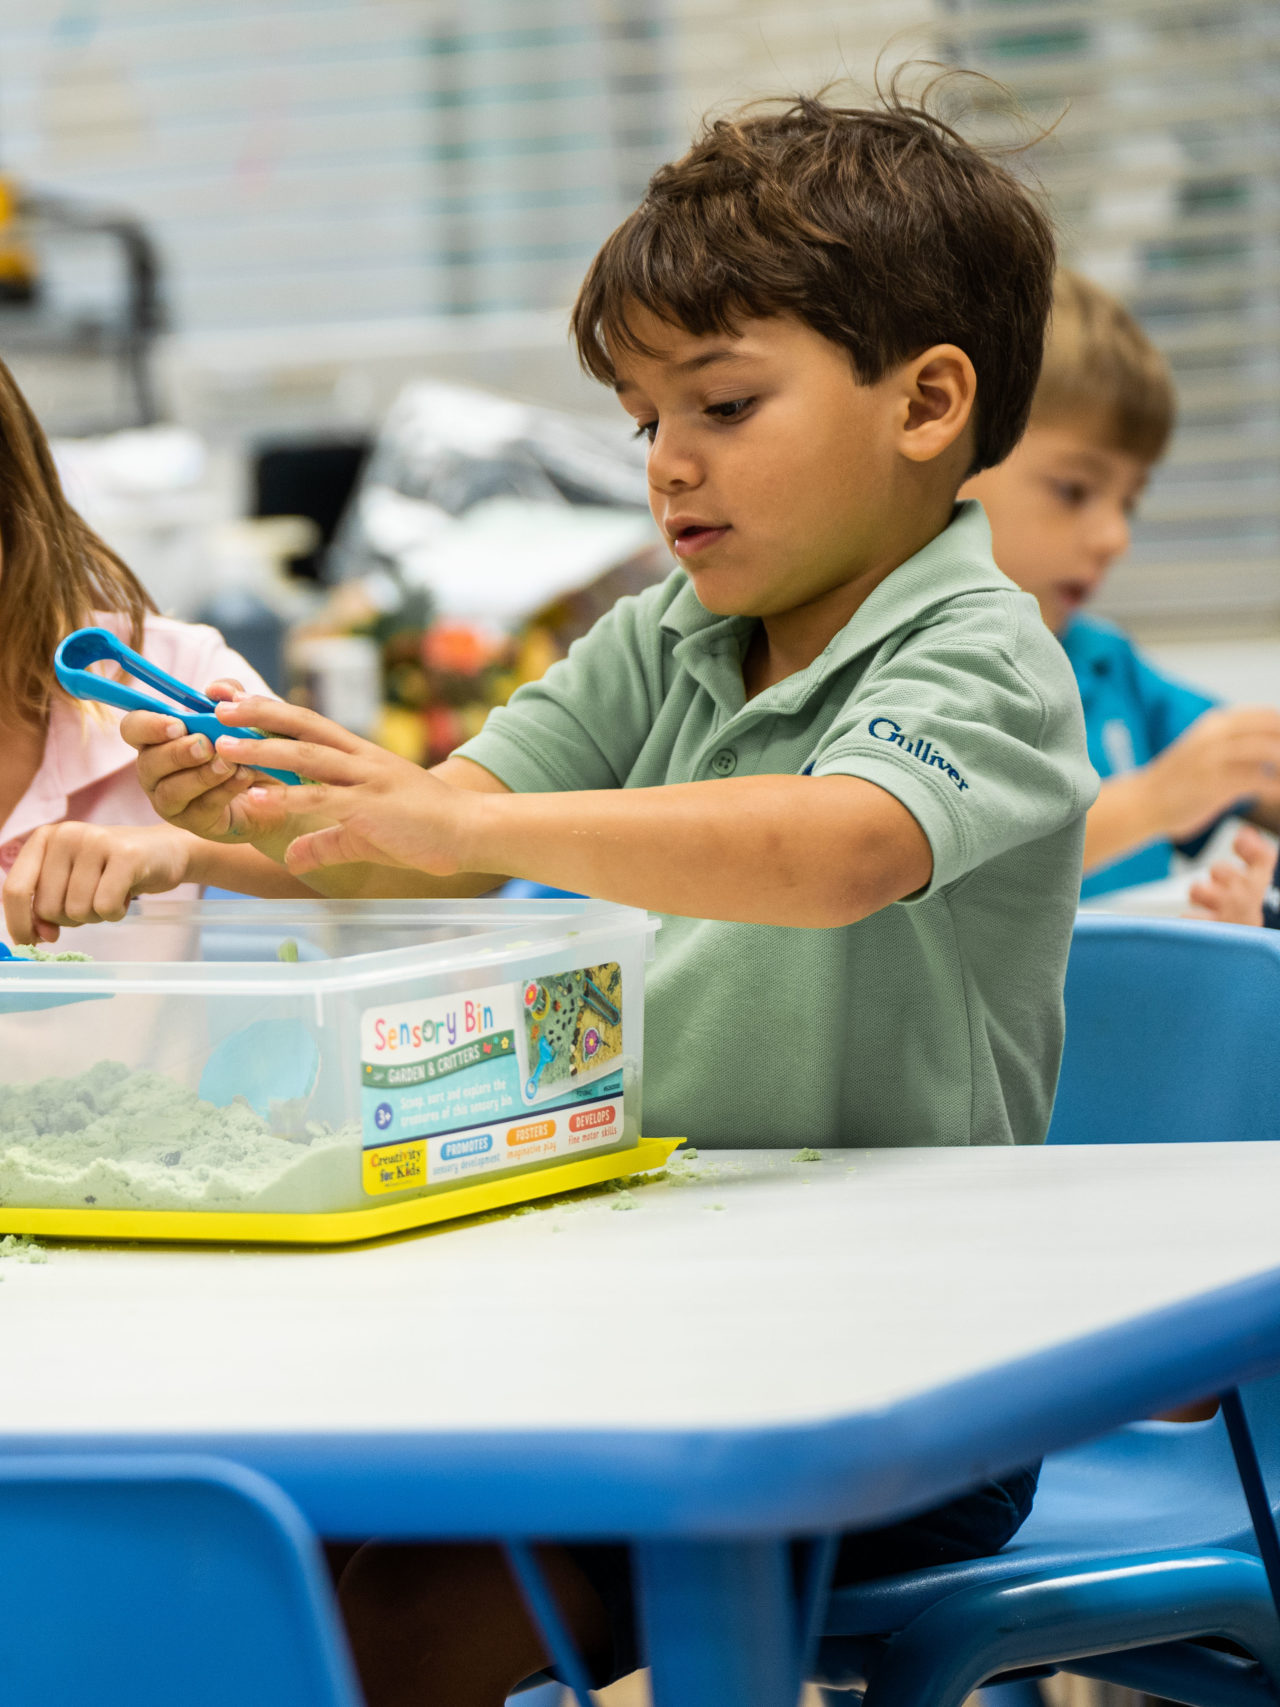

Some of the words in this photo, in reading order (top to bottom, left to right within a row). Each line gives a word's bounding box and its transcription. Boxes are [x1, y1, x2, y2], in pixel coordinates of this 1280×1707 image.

[868, 717, 969, 792] Gulliver
[374, 1012, 457, 1051] Sensory
[464, 1000, 494, 1034] Bin
[388, 1063, 426, 1084] GARDEN
[427, 1061, 436, 1077] &
[438, 1044, 480, 1073] CRITTERS
[447, 1087, 461, 1101] and
[463, 1083, 491, 1099] explore
[493, 1079, 506, 1091] the
[377, 1108, 391, 1126] 3+
[442, 1105, 451, 1119] of
[453, 1103, 468, 1116] this
[470, 1098, 500, 1113] sensory
[501, 1094, 513, 1106] bin
[575, 1109, 610, 1128] DEVELOPS
[516, 1124, 549, 1142] FOSTERS
[581, 1131, 600, 1143] motor
[601, 1126, 618, 1139] skills
[445, 1135, 489, 1157] PROMOTES
[371, 1148, 423, 1168] Creativity
[461, 1153, 501, 1170] development
[380, 1168, 395, 1183] for
[396, 1160, 422, 1179] Kids
